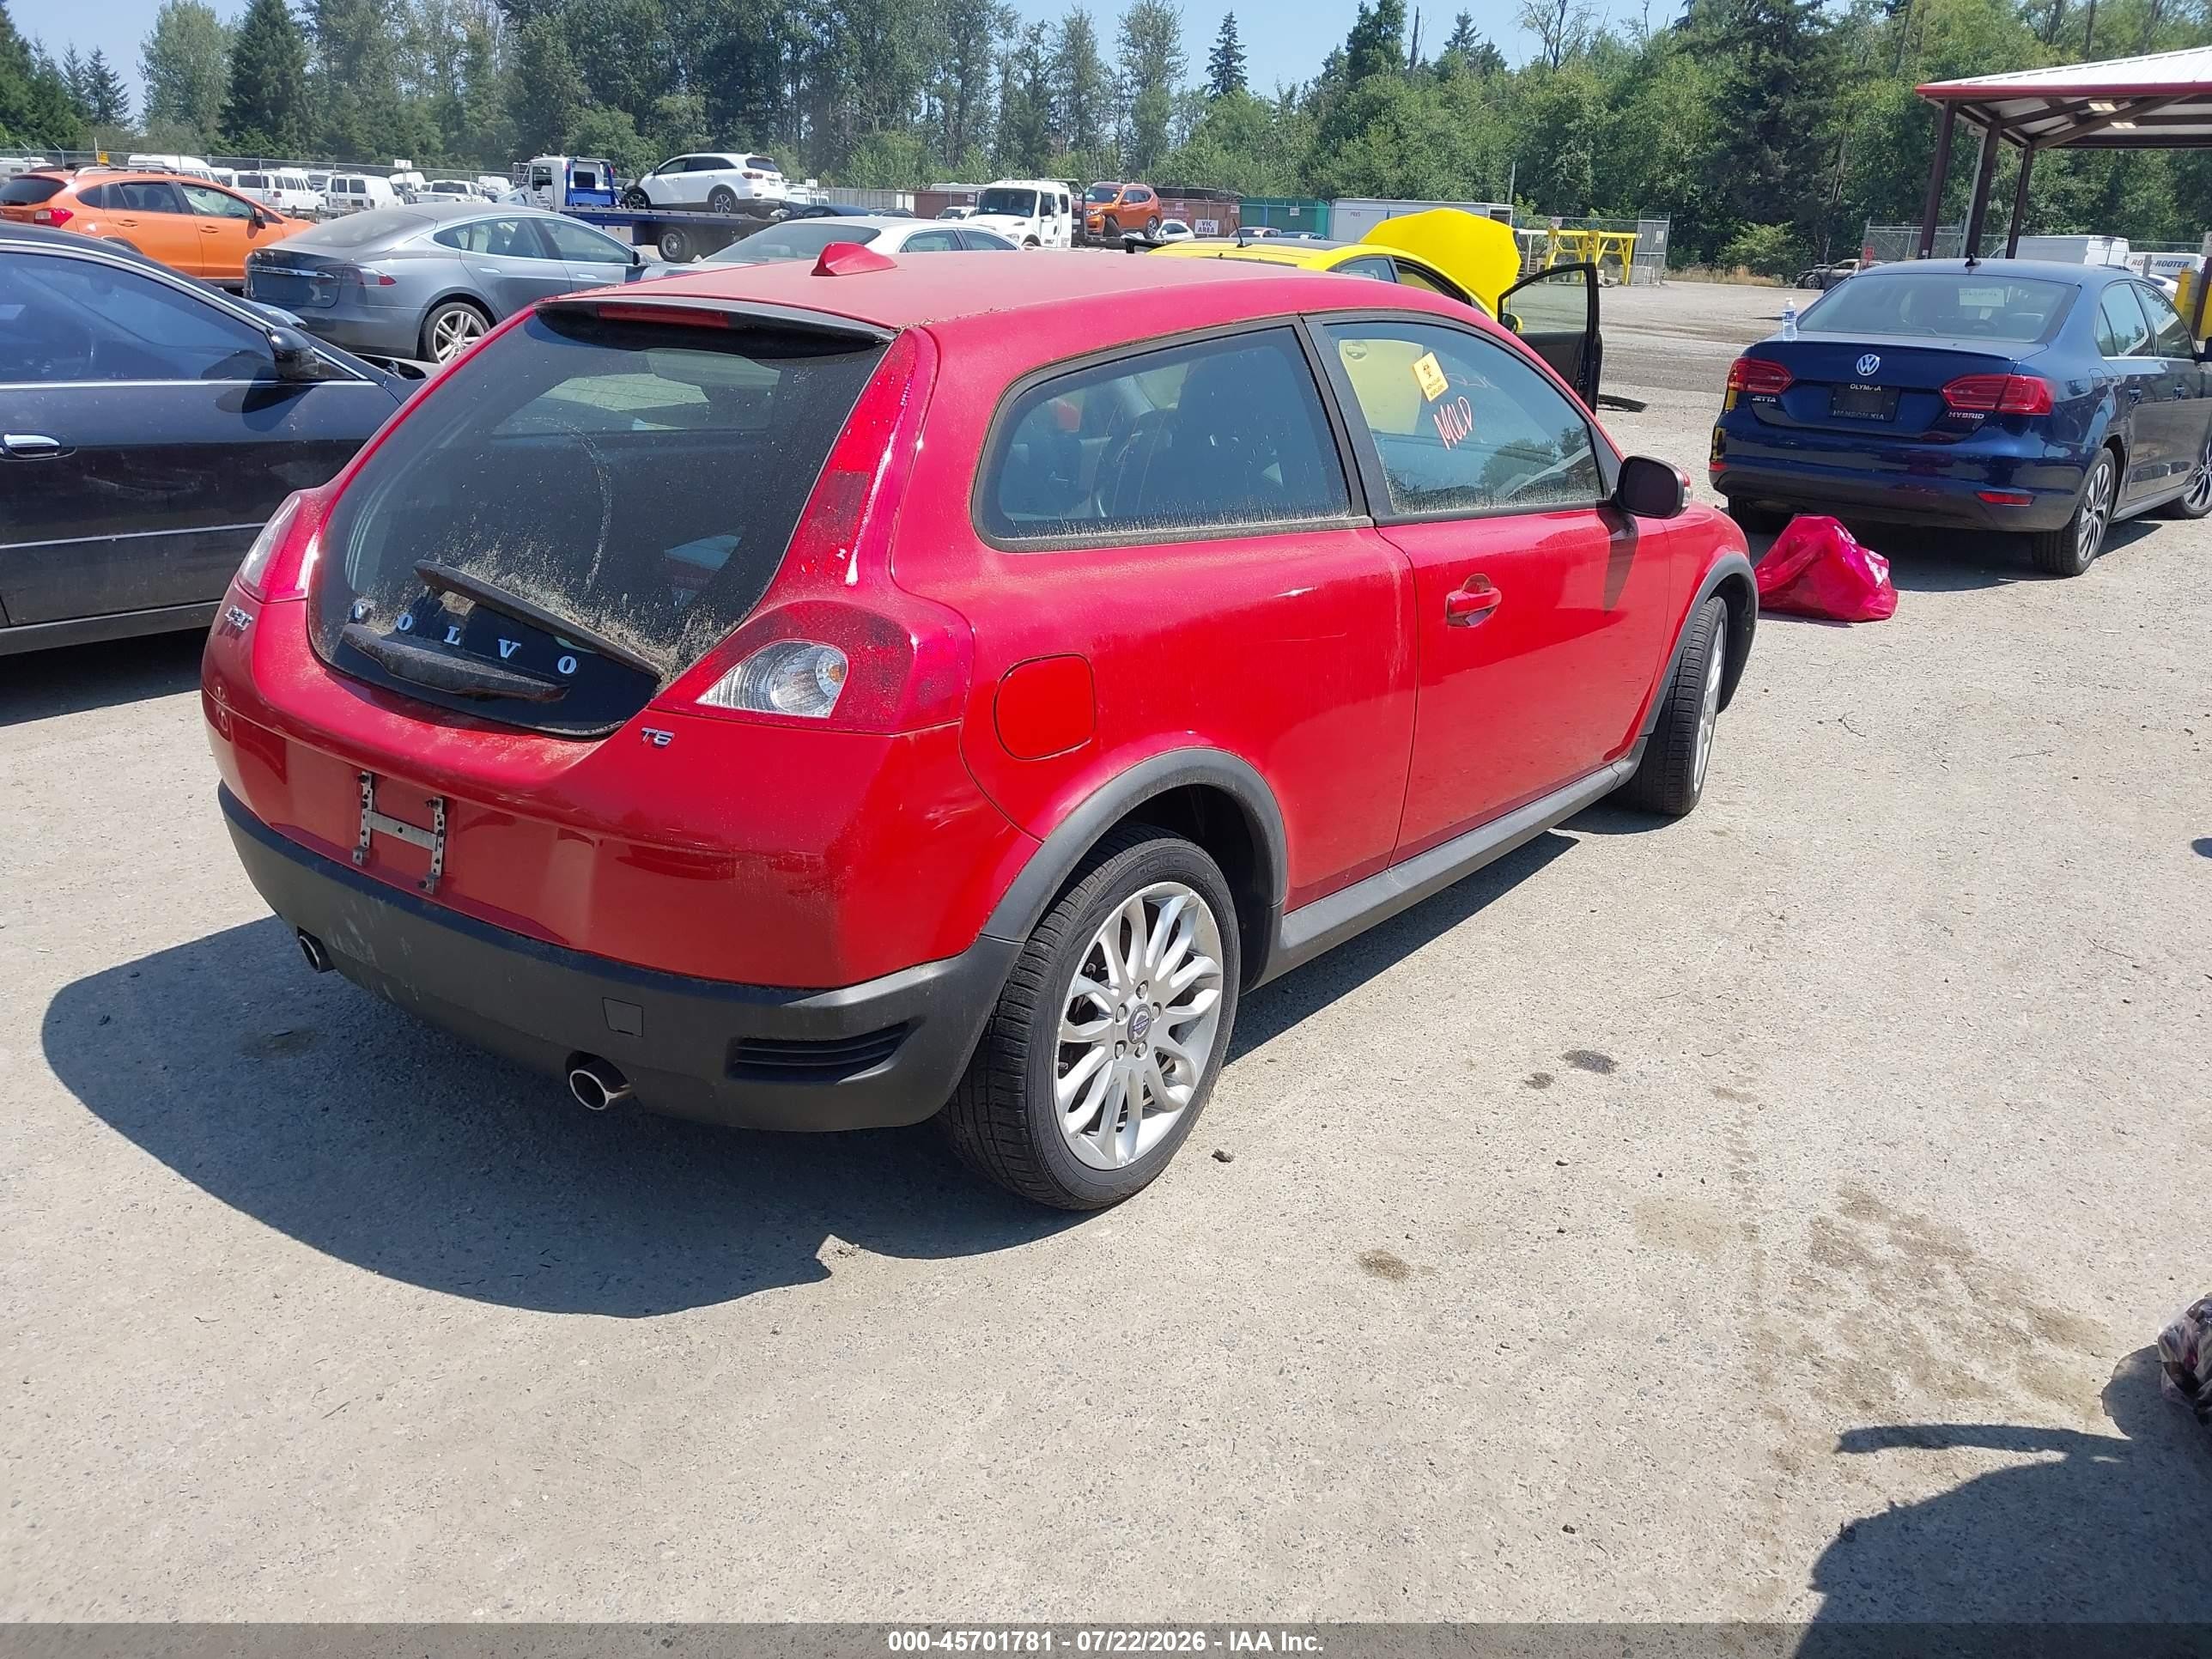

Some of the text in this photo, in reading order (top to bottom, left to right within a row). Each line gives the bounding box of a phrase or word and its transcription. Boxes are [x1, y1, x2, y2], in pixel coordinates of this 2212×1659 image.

[1752, 395, 1777, 404] JETTA
[1948, 411, 1985, 420] HYBRID
[353, 599, 578, 675] VOLVO
[641, 726, 675, 745] T5
